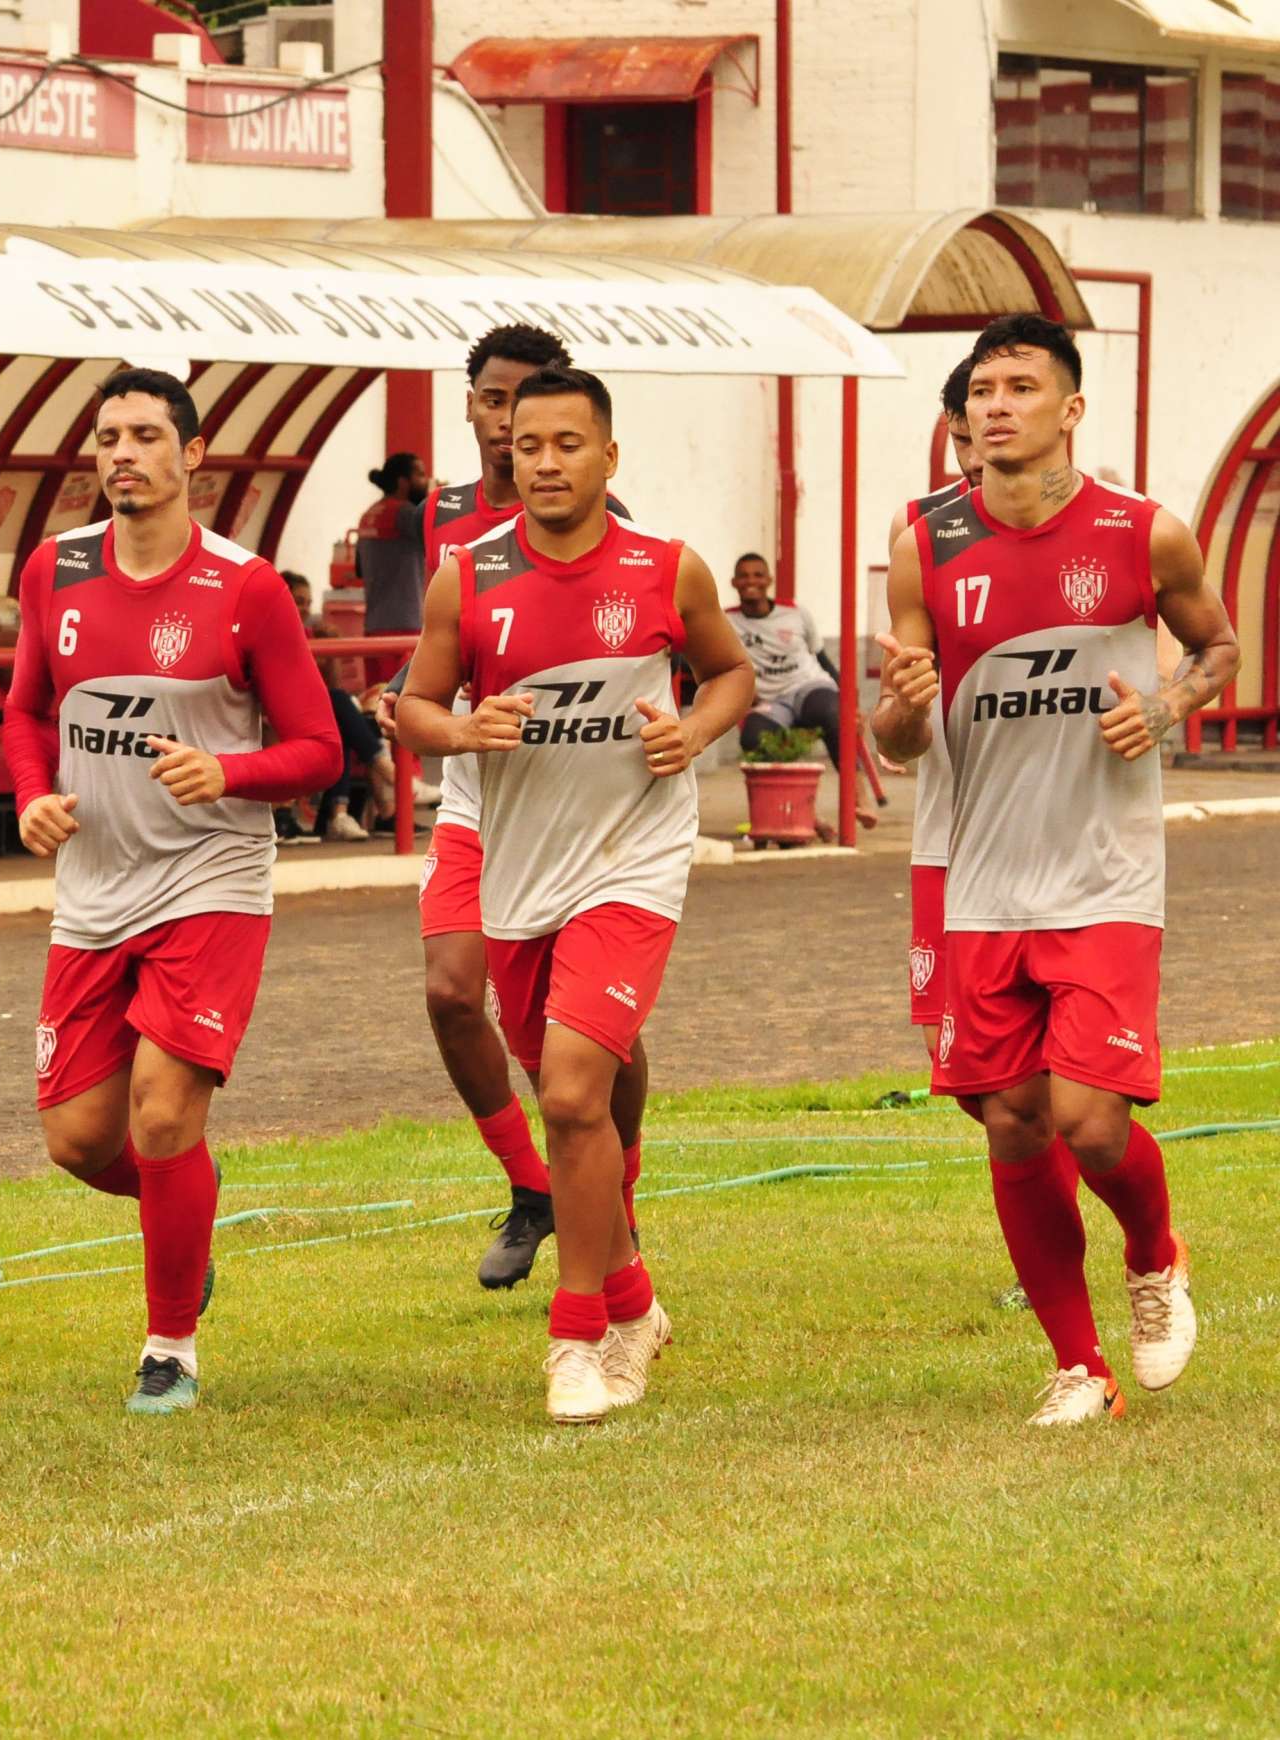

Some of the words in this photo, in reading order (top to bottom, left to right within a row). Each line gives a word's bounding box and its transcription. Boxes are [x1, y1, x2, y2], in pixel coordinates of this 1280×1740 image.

[224, 93, 348, 156] VISITANTE
[37, 281, 203, 331] SEJA
[191, 287, 299, 335] UM
[955, 574, 991, 628] 17
[58, 608, 81, 657] 6
[491, 607, 515, 656] 7
[68, 723, 177, 758] naka
[521, 715, 633, 745] akal
